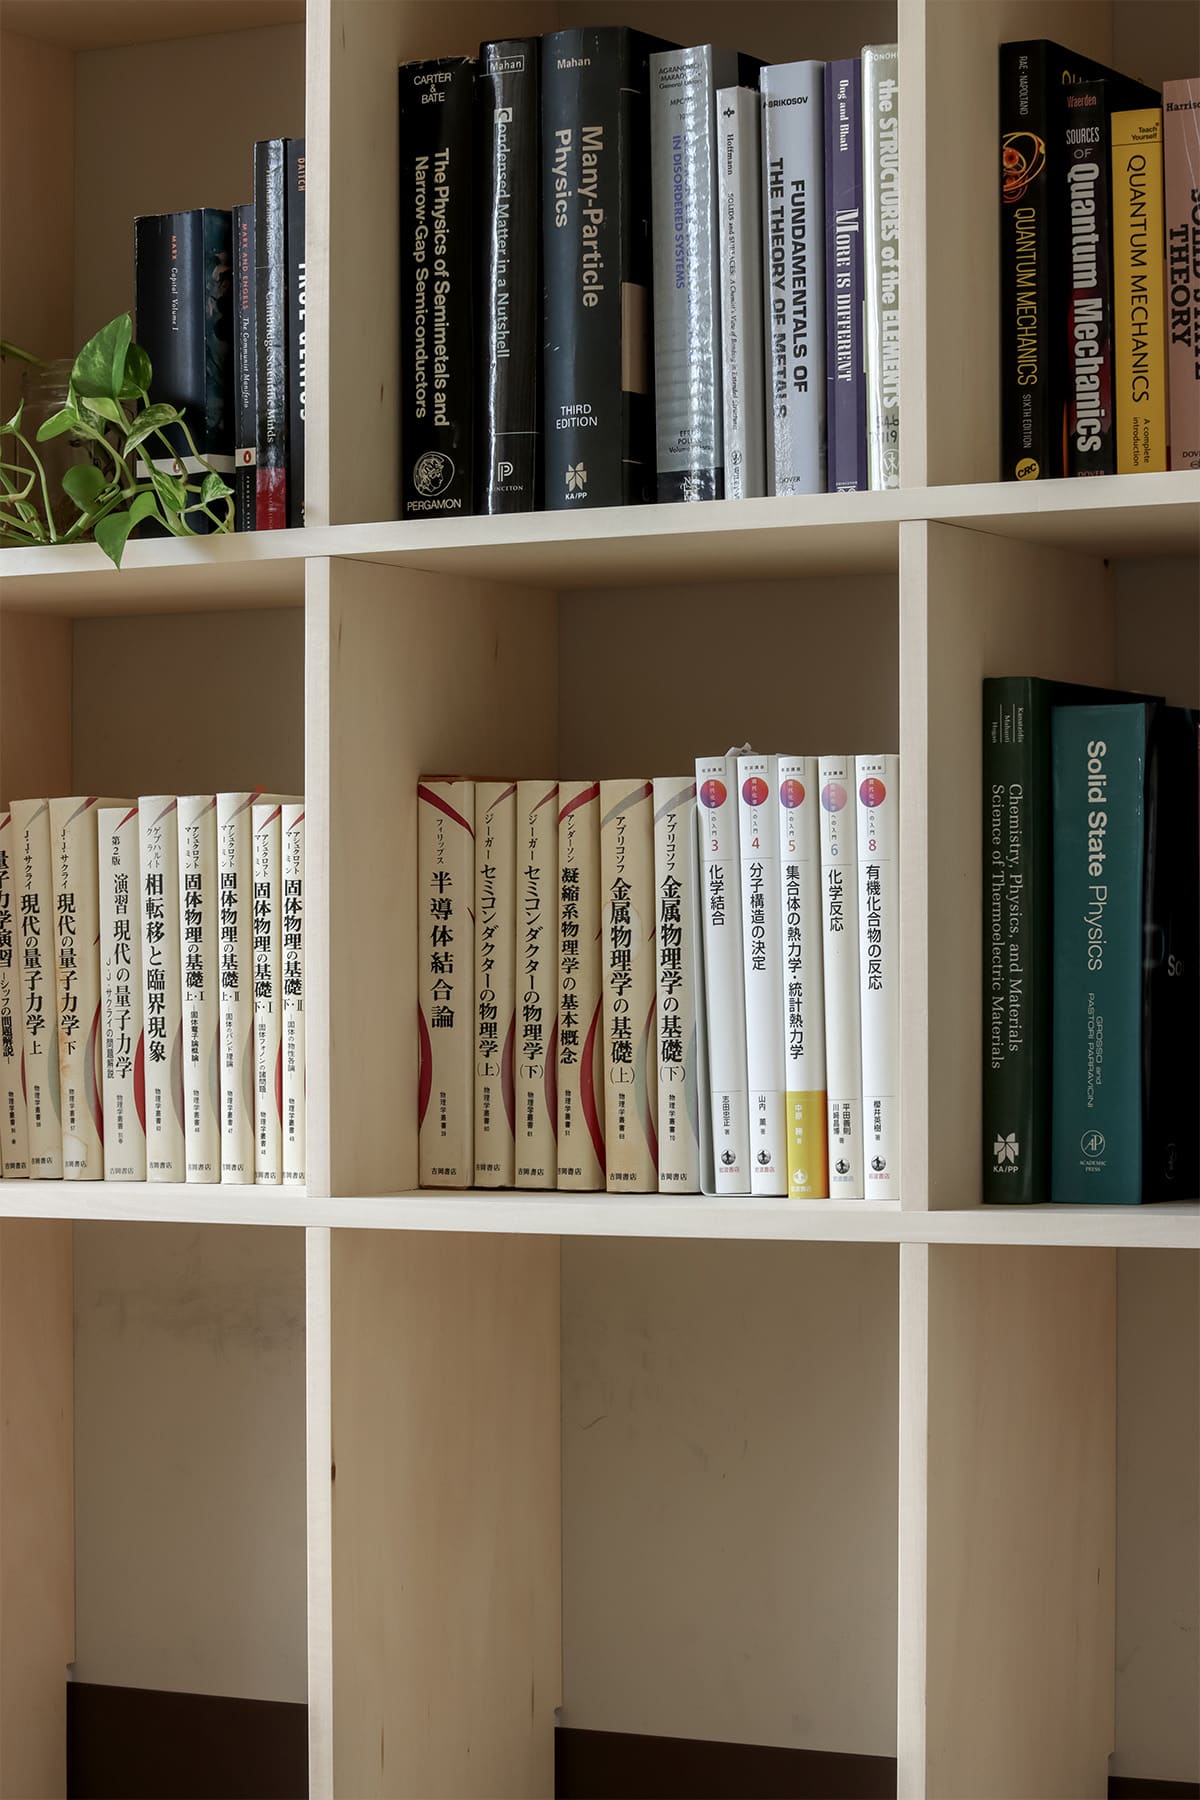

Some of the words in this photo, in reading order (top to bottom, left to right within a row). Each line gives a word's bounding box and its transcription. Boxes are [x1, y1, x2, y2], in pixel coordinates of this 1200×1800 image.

[414, 72, 452, 86] CARTER
[430, 84, 436, 92] &
[490, 59, 522, 72] Mahan
[556, 58, 591, 70] Mahan
[1019, 56, 1028, 70] RAE
[422, 92, 446, 104] BATE
[762, 96, 808, 108] ABRIKOSOV
[838, 80, 849, 100] Ong
[840, 102, 849, 121] and
[878, 79, 899, 112] the
[1067, 94, 1096, 108] Waerden
[495, 108, 511, 199] Condensed
[673, 135, 682, 150] IN
[840, 124, 849, 152] Bhatt
[1066, 126, 1100, 145] SOURCES
[1074, 148, 1094, 160] OF
[1131, 133, 1157, 141] Yourself
[434, 148, 449, 183] The
[552, 128, 572, 228] Physics
[770, 157, 784, 199] THE
[879, 118, 899, 241] STRUCTURES
[416, 156, 429, 262] Narrow-Gap
[578, 126, 604, 308] Many-Particle
[674, 154, 683, 232] DISORDERED
[1127, 154, 1149, 268] QUANTUM
[432, 186, 450, 255] Physics
[497, 204, 510, 254] Matter
[1067, 162, 1100, 288] Quantum
[434, 258, 450, 276] of
[497, 257, 510, 273] in
[675, 234, 684, 289] SYSTEMS
[770, 206, 786, 290] THEORY
[791, 180, 807, 358] FUNDAMENTALS
[881, 246, 899, 268] of
[1013, 207, 1036, 287] QUANTUM
[497, 278, 506, 288] a
[836, 272, 851, 288] IS
[881, 269, 899, 304] the
[1170, 224, 1192, 349] THEORY
[264, 292, 274, 352] Cambridge
[434, 280, 450, 390] Semimetals
[497, 294, 510, 358] Nutshell
[773, 298, 786, 325] OF
[415, 268, 429, 418] Semiconductors
[837, 294, 852, 382] DIFFERENT
[882, 310, 899, 408] ELEMENTS
[1016, 292, 1037, 386] MECHANICS
[1130, 275, 1150, 402] MECHANICS
[266, 354, 276, 406] Scientific
[794, 366, 808, 392] OF
[1073, 298, 1105, 452] Mechanics
[266, 409, 276, 442] Minds
[434, 394, 450, 426] and
[556, 416, 598, 430] EDITION
[560, 404, 592, 416] THIRD
[1022, 394, 1032, 417] SIXTH
[1144, 418, 1150, 426] A
[1022, 419, 1032, 448] EDITION
[1142, 429, 1150, 464] complete
[566, 492, 588, 500] KA/PP
[1018, 463, 1037, 478] CRC
[407, 498, 462, 512] PERGAMON
[1087, 740, 1107, 803] Solid
[485, 813, 494, 860] ジーガー
[528, 814, 538, 861] ジーガー
[567, 814, 576, 863] アンダーソン
[992, 784, 1004, 844] Science
[1006, 784, 1023, 868] Chemistry,
[111, 836, 121, 866] 第2版
[436, 819, 445, 864] フィリップス
[616, 816, 626, 874] アブリコソフ
[666, 813, 677, 871] アブリコソフ
[711, 840, 719, 851] 3
[752, 838, 760, 849] 4
[788, 840, 796, 852] 5
[831, 844, 838, 856] 6
[869, 840, 876, 851] 8
[992, 850, 1005, 867] of
[1088, 811, 1107, 877] State
[709, 864, 725, 926] 化学結合
[750, 862, 766, 970] 分子構造の決定
[828, 869, 844, 932] 化学反応
[1007, 874, 1023, 939] Physics,
[184, 873, 204, 988] 固体物理の基礎
[220, 872, 239, 988] 固体物理の基礎
[254, 882, 272, 998] 固体物理の基礎
[284, 879, 302, 996] 固体物理の基礎
[430, 871, 455, 1028] 半導体結合論
[866, 865, 882, 990] 有機化合物の反応
[992, 871, 1005, 991] Thermoelectric
[1084, 886, 1107, 971] Physics
[20, 893, 45, 1036] 現代の量子力学
[57, 892, 80, 1036] 現代の量子力学
[145, 874, 166, 1062] 相転移と臨界現象
[479, 864, 499, 1058] セミコンダクターの物理学
[523, 865, 543, 1060] セミコンダクターの物理学
[560, 867, 580, 1064] 凝縮系物理学の基本概念
[610, 877, 632, 1064] 金属物理学の基礎
[660, 875, 682, 1063] 金属物理学の基礎
[1009, 944, 1023, 976] and
[991, 997, 1005, 1070] Materials
[1009, 979, 1023, 1052] Materials
[30, 1040, 42, 1055] 上
[67, 1040, 77, 1056] 下
